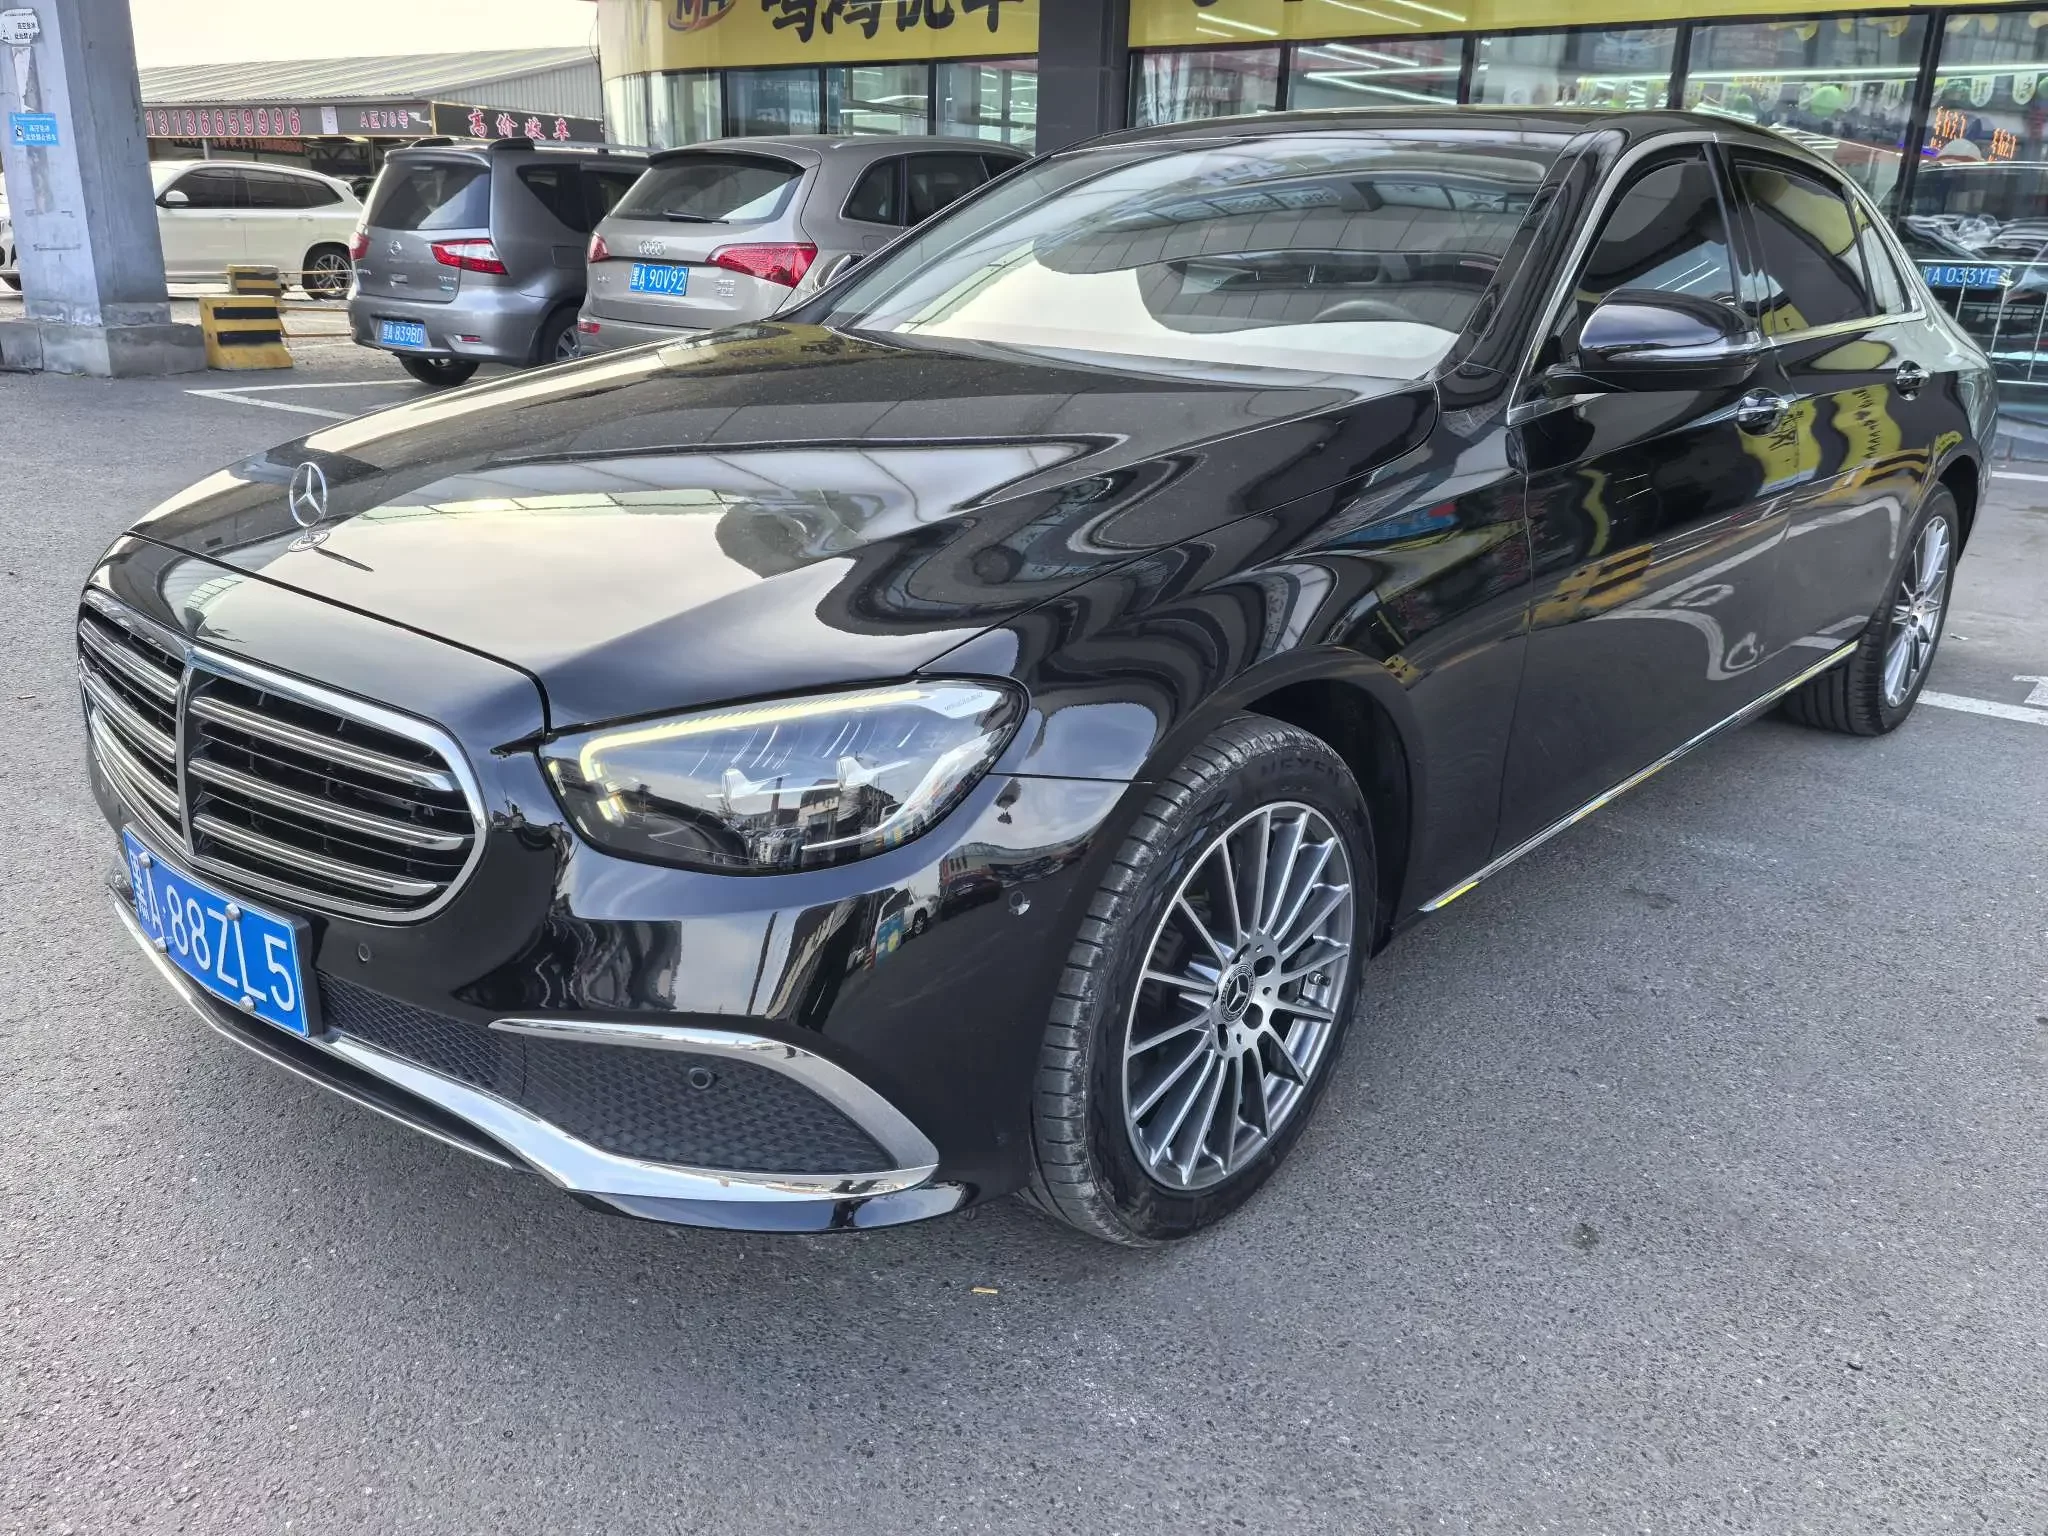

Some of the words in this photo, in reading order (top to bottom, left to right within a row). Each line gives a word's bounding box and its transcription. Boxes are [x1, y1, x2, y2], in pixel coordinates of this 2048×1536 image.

[145, 107, 301, 137] 13136659996
[468, 107, 571, 142] 高价收车
